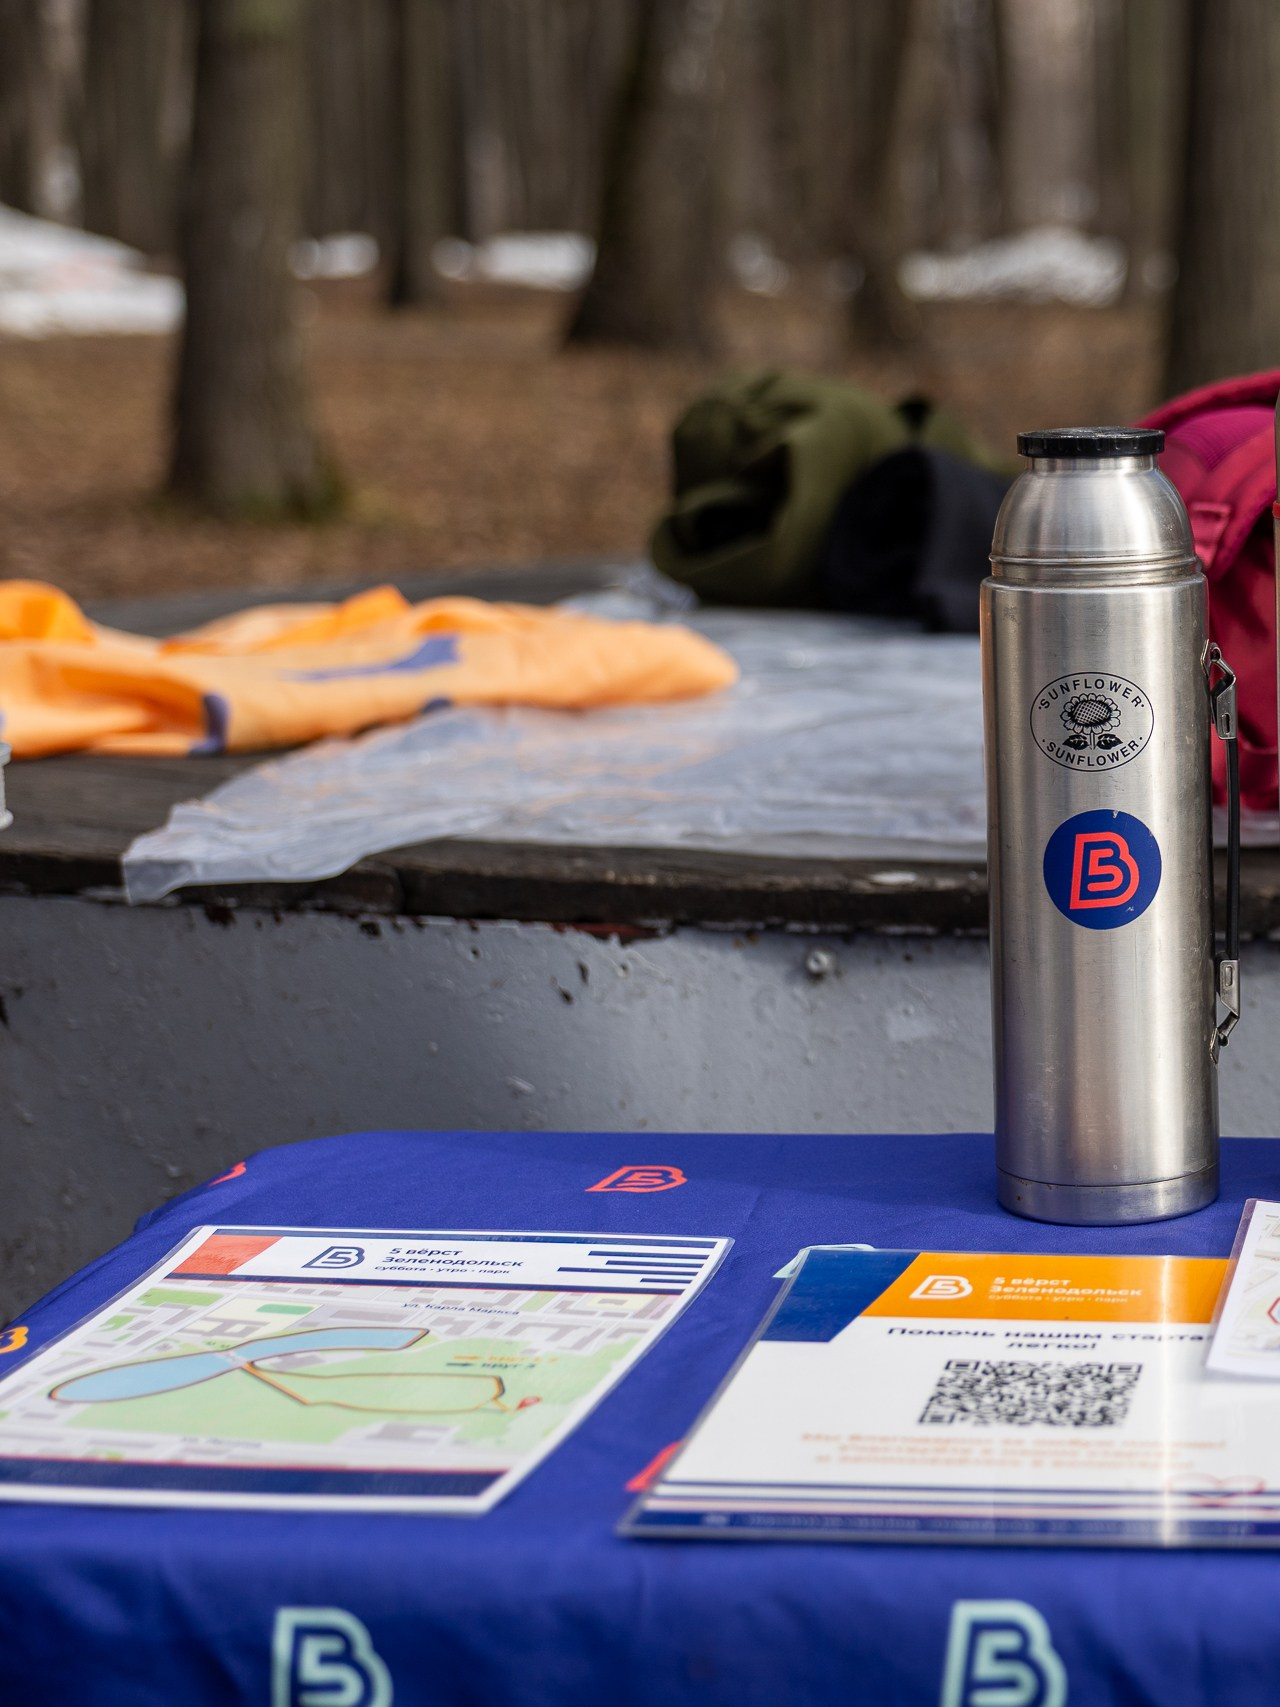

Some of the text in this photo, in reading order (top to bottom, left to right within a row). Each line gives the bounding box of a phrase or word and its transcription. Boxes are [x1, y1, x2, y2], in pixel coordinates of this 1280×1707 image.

[1040, 678, 1143, 709] SUNFLOWER
[1046, 739, 1140, 767] SUNFLOWER
[389, 1247, 464, 1257] 5 вёрст
[382, 1256, 524, 1266] Зеленодольск
[992, 1276, 1072, 1287] 5 вёрст
[989, 1285, 1144, 1296] Зеленодольск
[886, 1327, 996, 1338] Помочь
[1004, 1331, 1103, 1340] нашим
[1006, 1341, 1099, 1350] легко!
